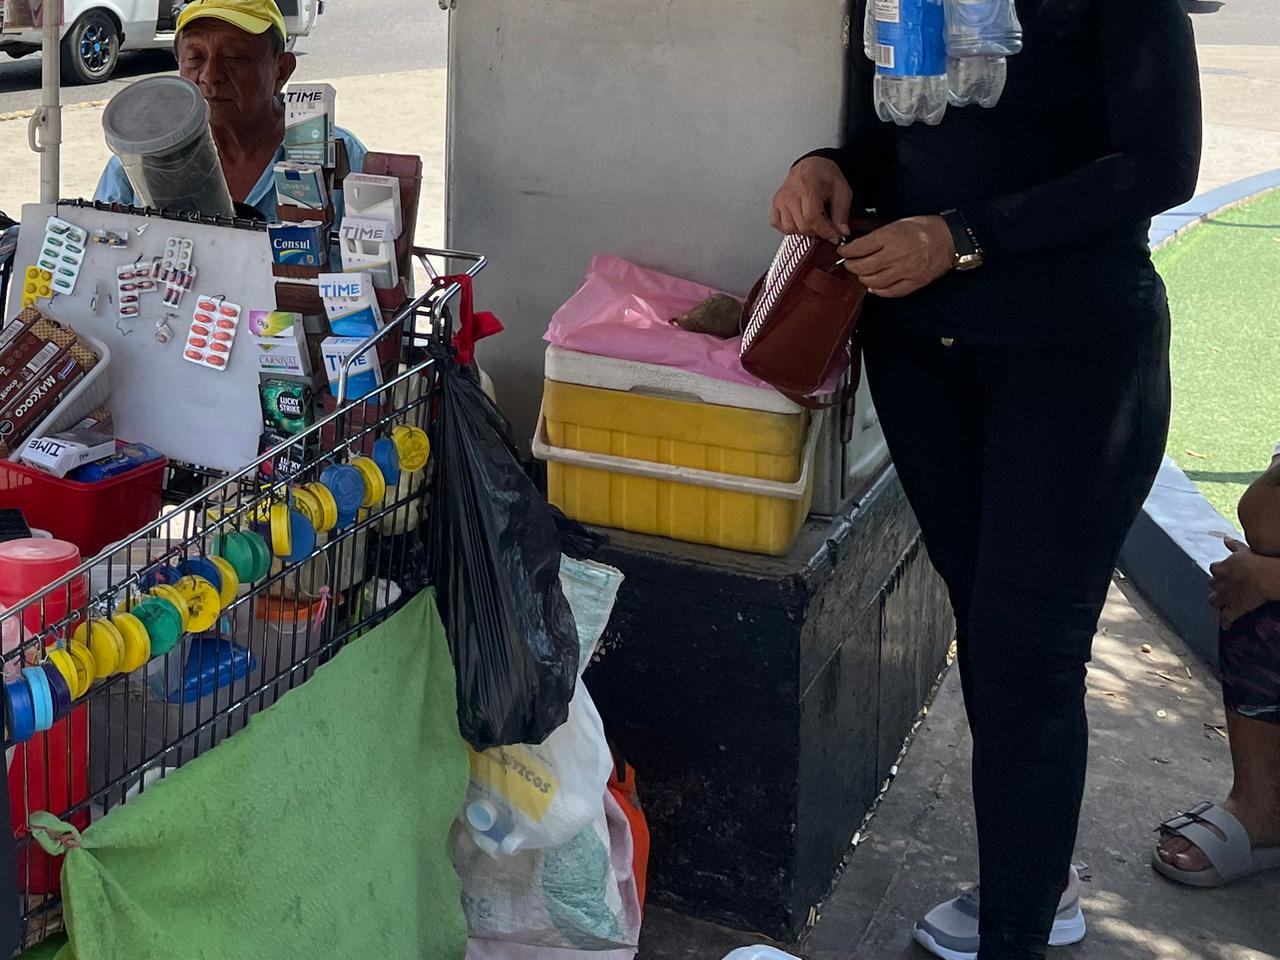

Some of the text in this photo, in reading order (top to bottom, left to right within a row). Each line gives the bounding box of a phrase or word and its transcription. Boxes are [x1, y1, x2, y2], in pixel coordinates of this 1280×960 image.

[286, 91, 323, 103] TIME
[342, 226, 385, 240] TIME
[273, 238, 310, 250] Consul
[320, 283, 361, 298] TIME
[258, 355, 299, 367] CARNIVAL
[15, 375, 56, 417] MAXCOCO
[280, 396, 300, 406] LUCKY
[279, 403, 301, 413] STRIKE
[28, 440, 66, 457] TIME
[280, 456, 302, 471] LUKY
